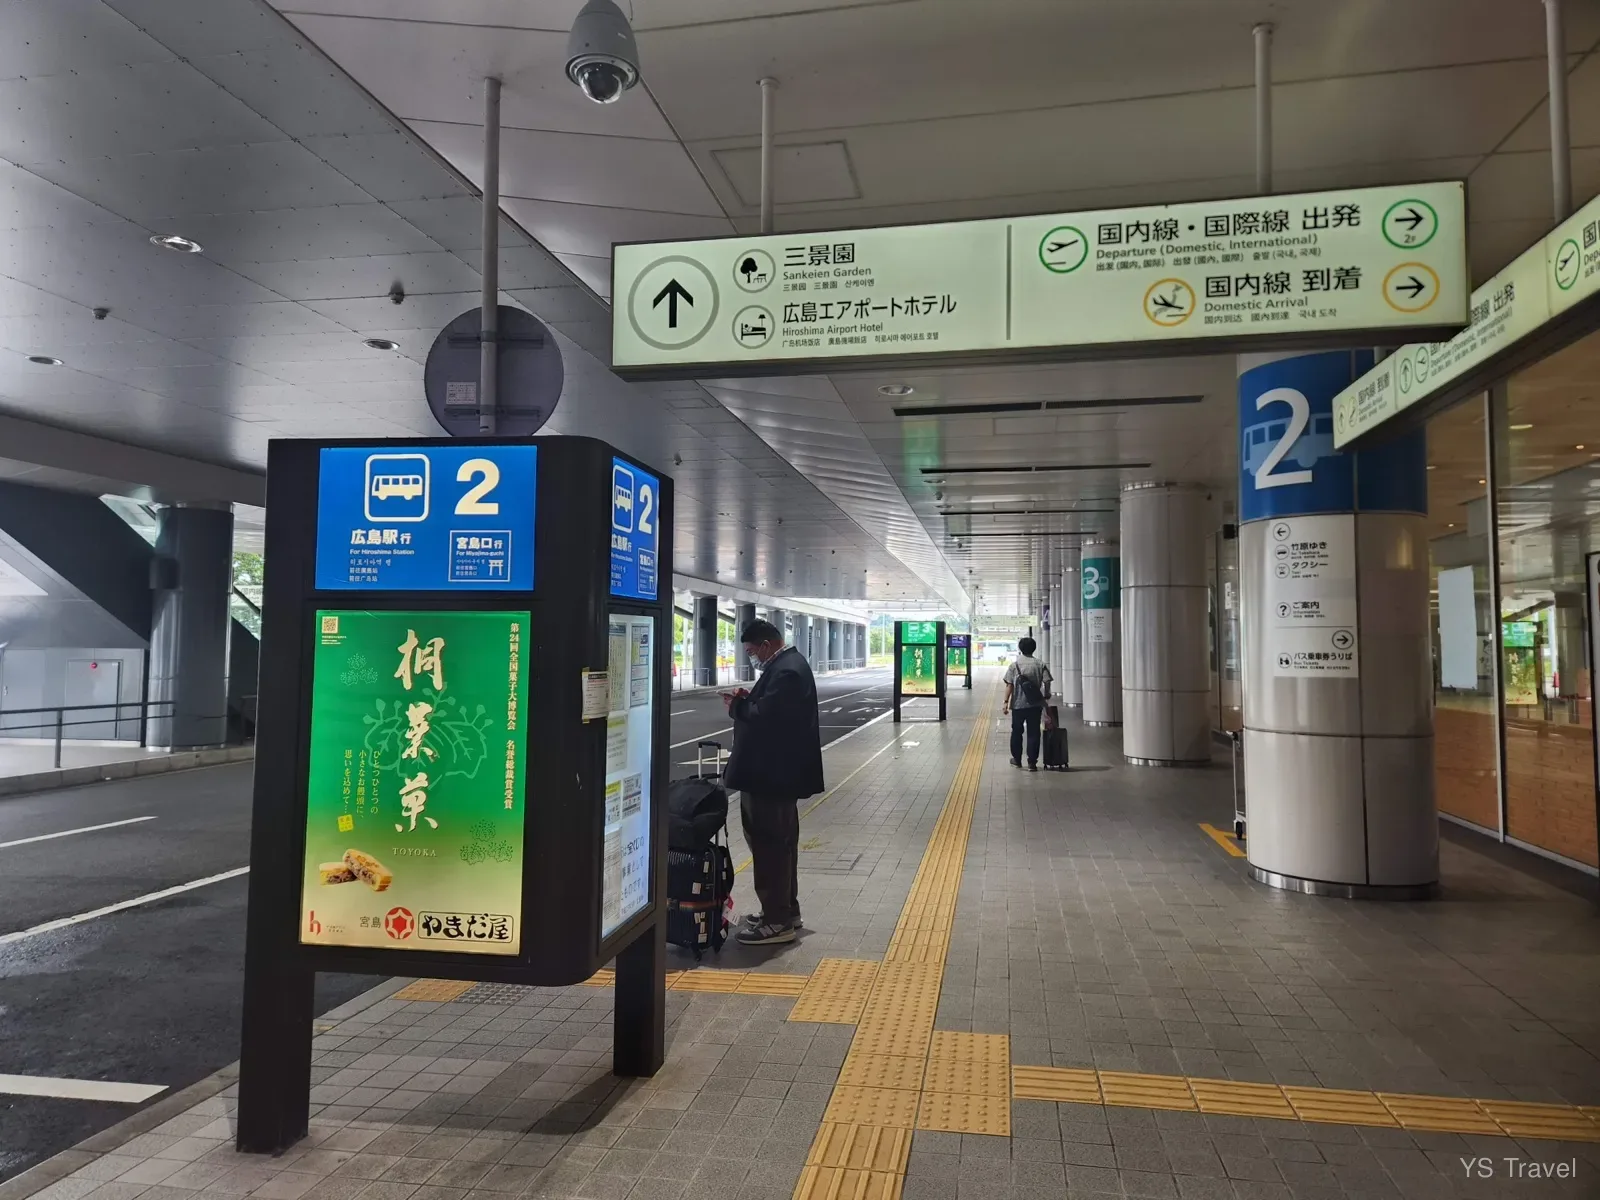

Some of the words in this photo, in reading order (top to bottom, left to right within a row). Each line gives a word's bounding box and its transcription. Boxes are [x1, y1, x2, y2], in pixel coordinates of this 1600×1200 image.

[1098, 209, 1289, 245] 国内線・国際線
[1302, 203, 1360, 230] 出発
[1404, 234, 1416, 244] 2F
[1583, 220, 1600, 250] 国
[783, 242, 855, 267] 三景園
[1096, 247, 1156, 260] Departure
[1160, 241, 1225, 256] (Domestic,
[1229, 233, 1318, 250] International)
[783, 269, 830, 281] Sankeien
[833, 266, 872, 278] Garden
[1205, 270, 1291, 298] 国内線
[1302, 265, 1362, 292] 到着
[814, 280, 838, 290] 三景園
[844, 278, 875, 288] 산케이엔
[783, 294, 957, 324] 広島エアポートホテル
[1204, 300, 1262, 312] Domestic
[1265, 296, 1308, 309] Arrival
[1299, 308, 1316, 319] 국내
[1318, 308, 1337, 318] 도착
[782, 325, 825, 337] Hiroshima
[827, 323, 857, 336] Airport
[860, 322, 883, 332] Hotel
[875, 334, 899, 344] 히로시마
[900, 332, 925, 342] 에어포트
[1255, 387, 1313, 490] 2
[454, 458, 500, 515] 2
[638, 483, 653, 535] 2
[350, 529, 412, 545] 広島駅行
[456, 537, 503, 549] 宮島口行
[1291, 541, 1327, 551] 竹原ゆき
[1291, 561, 1328, 569] タクシー
[1084, 566, 1100, 600] 3
[1293, 601, 1320, 609] ご案内
[1294, 652, 1353, 660] バス乗車券うりば
[370, 750, 380, 814] ひとつひとつの
[392, 847, 438, 857] TOYOKA
[360, 916, 381, 928] 宮島
[421, 913, 509, 940] やまだ屋
